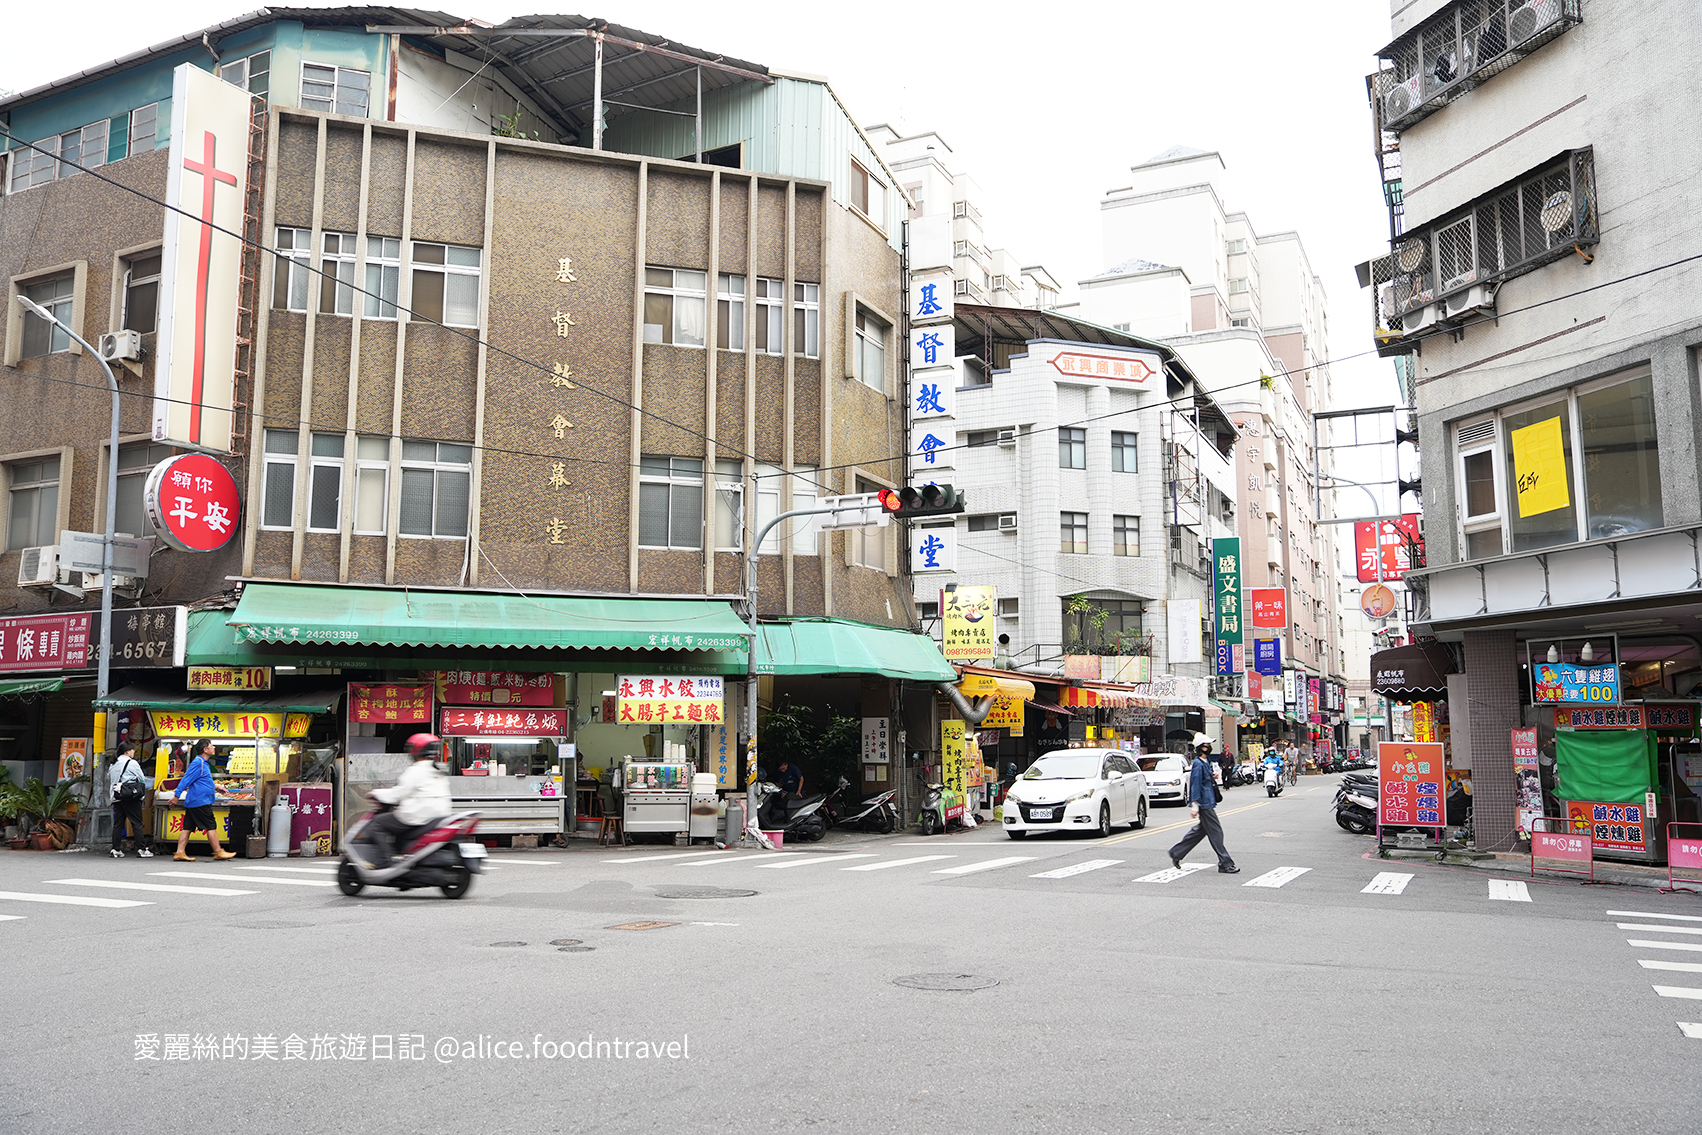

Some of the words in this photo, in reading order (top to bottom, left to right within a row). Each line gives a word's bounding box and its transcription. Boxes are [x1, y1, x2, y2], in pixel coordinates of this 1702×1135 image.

[546, 257, 577, 546] 基督教會幕堂
[916, 283, 946, 568] 基督教會堂
[170, 470, 213, 494] 願你
[169, 496, 231, 534] 平安
[1219, 555, 1238, 634] 盛文書局
[306, 630, 359, 639] 24263399
[648, 634, 694, 646] 宏祥帆布
[697, 637, 741, 647] 24263399
[1218, 639, 1227, 672] BOOK
[191, 670, 232, 686] 烤肉串燒
[1560, 667, 1615, 684] 六隻雞翅
[619, 678, 695, 698] 永興水餃
[620, 703, 720, 722] 大腸手工麵線
[159, 715, 224, 733] 烤肉串燒
